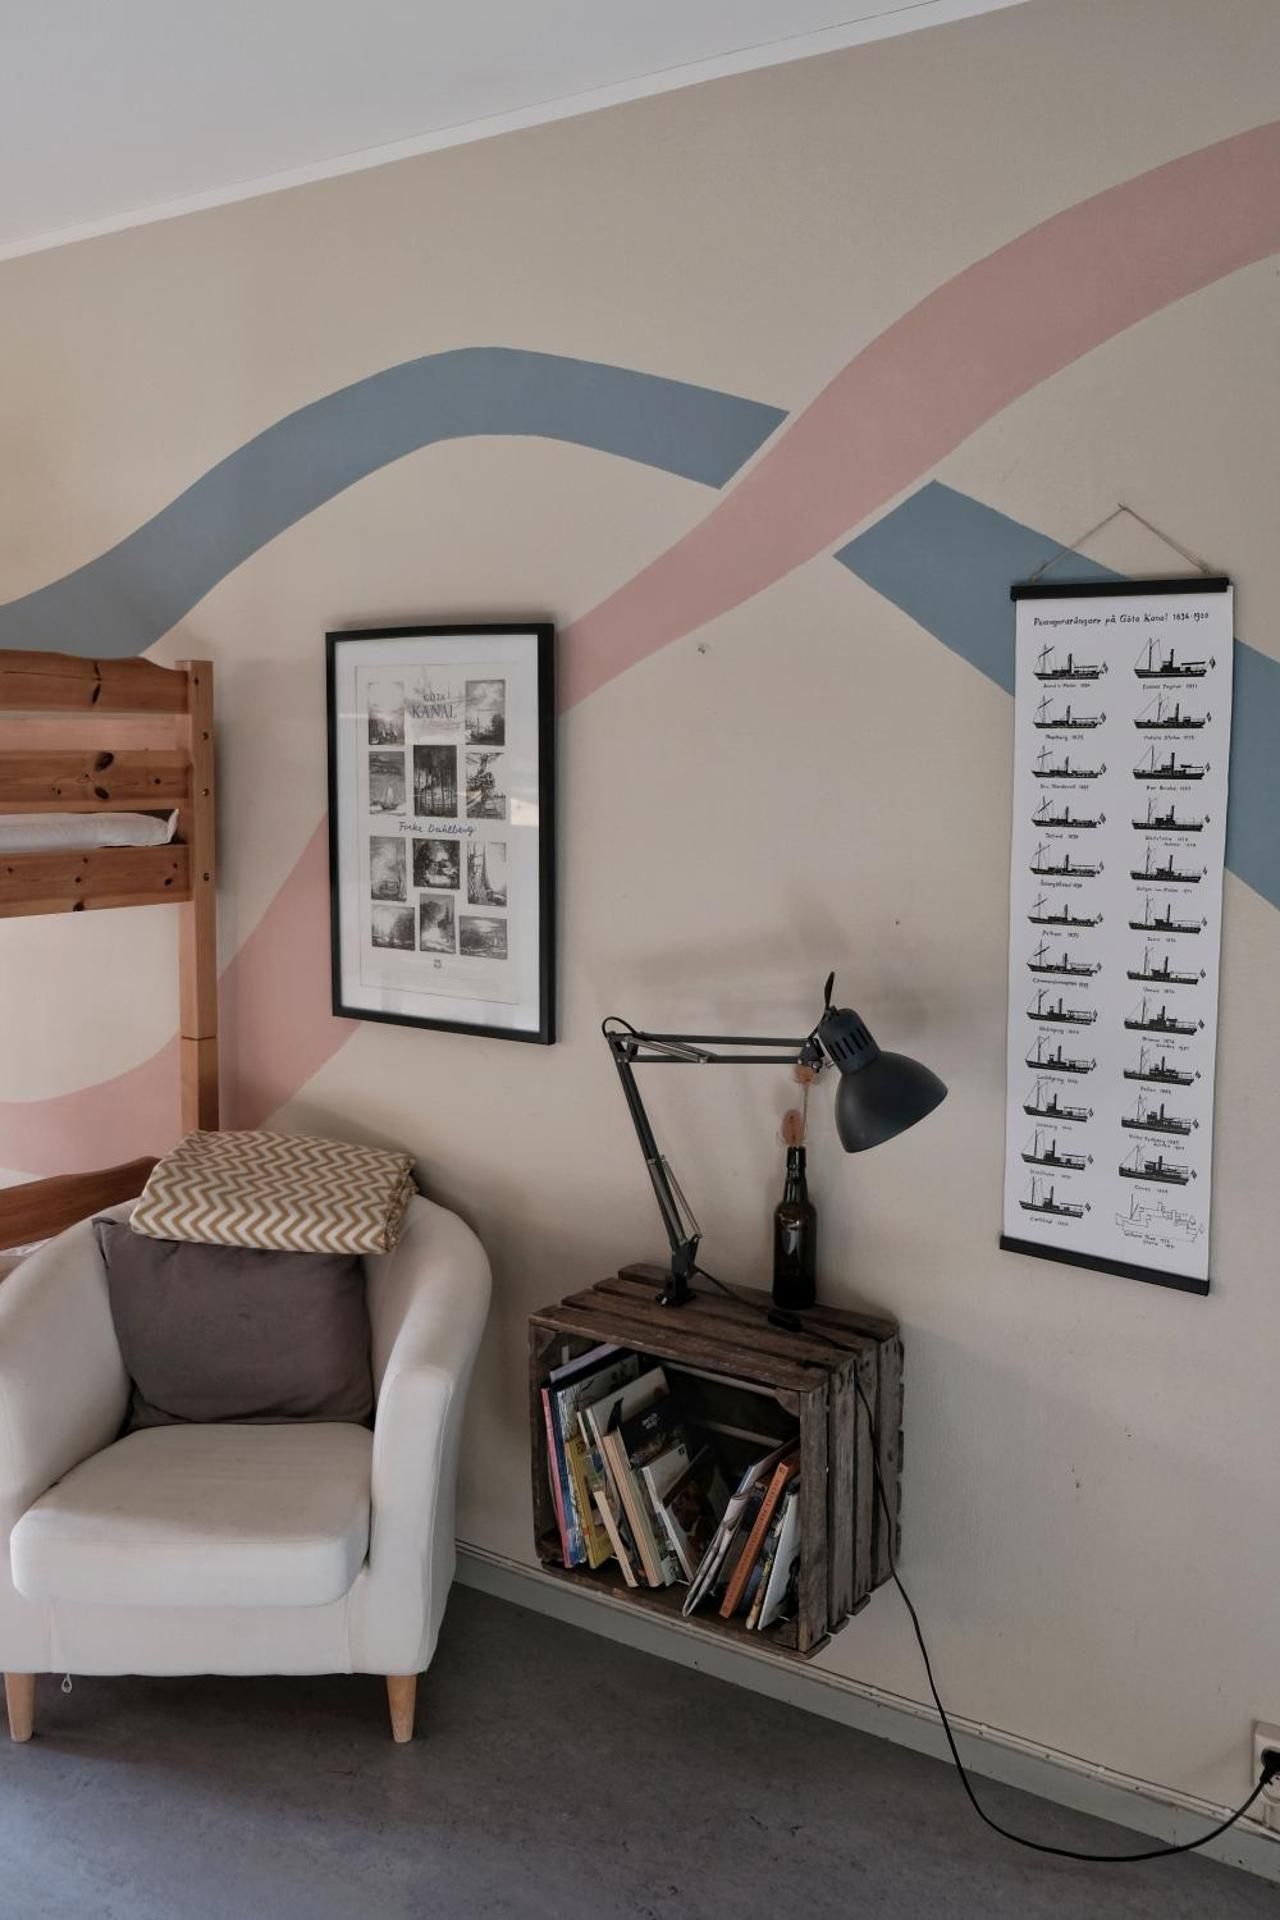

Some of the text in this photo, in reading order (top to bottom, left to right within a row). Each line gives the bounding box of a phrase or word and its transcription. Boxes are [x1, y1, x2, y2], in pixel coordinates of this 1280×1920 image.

[1104, 614, 1116, 627] på
[1119, 614, 1140, 623] Göta
[1143, 611, 1168, 623] Kanal
[412, 704, 457, 719] KANAL
